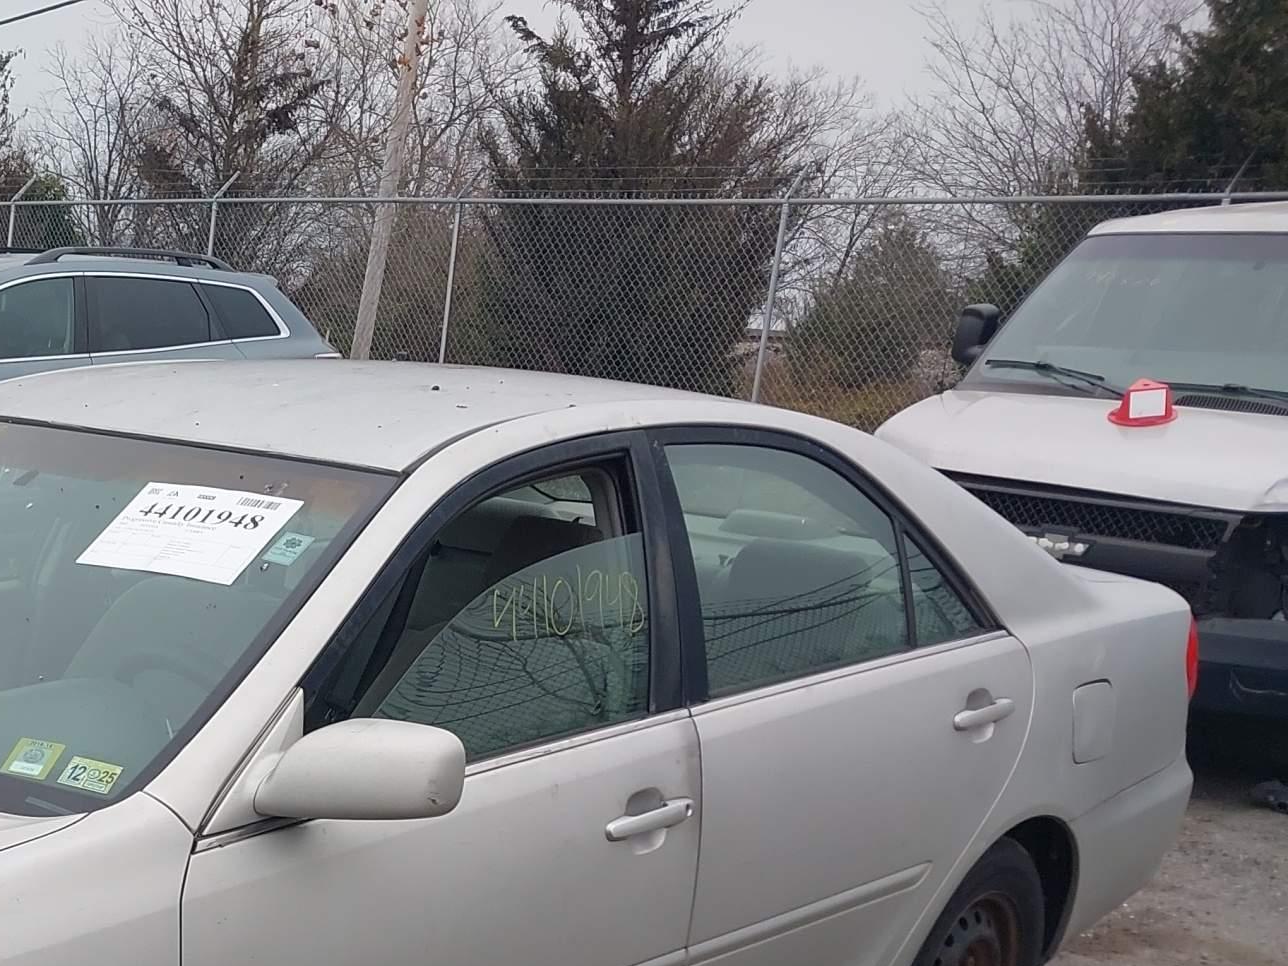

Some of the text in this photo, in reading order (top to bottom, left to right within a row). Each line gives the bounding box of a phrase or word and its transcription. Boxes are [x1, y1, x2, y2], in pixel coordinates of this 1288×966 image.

[139, 501, 265, 531] 44101948
[66, 763, 118, 785] 12 25
